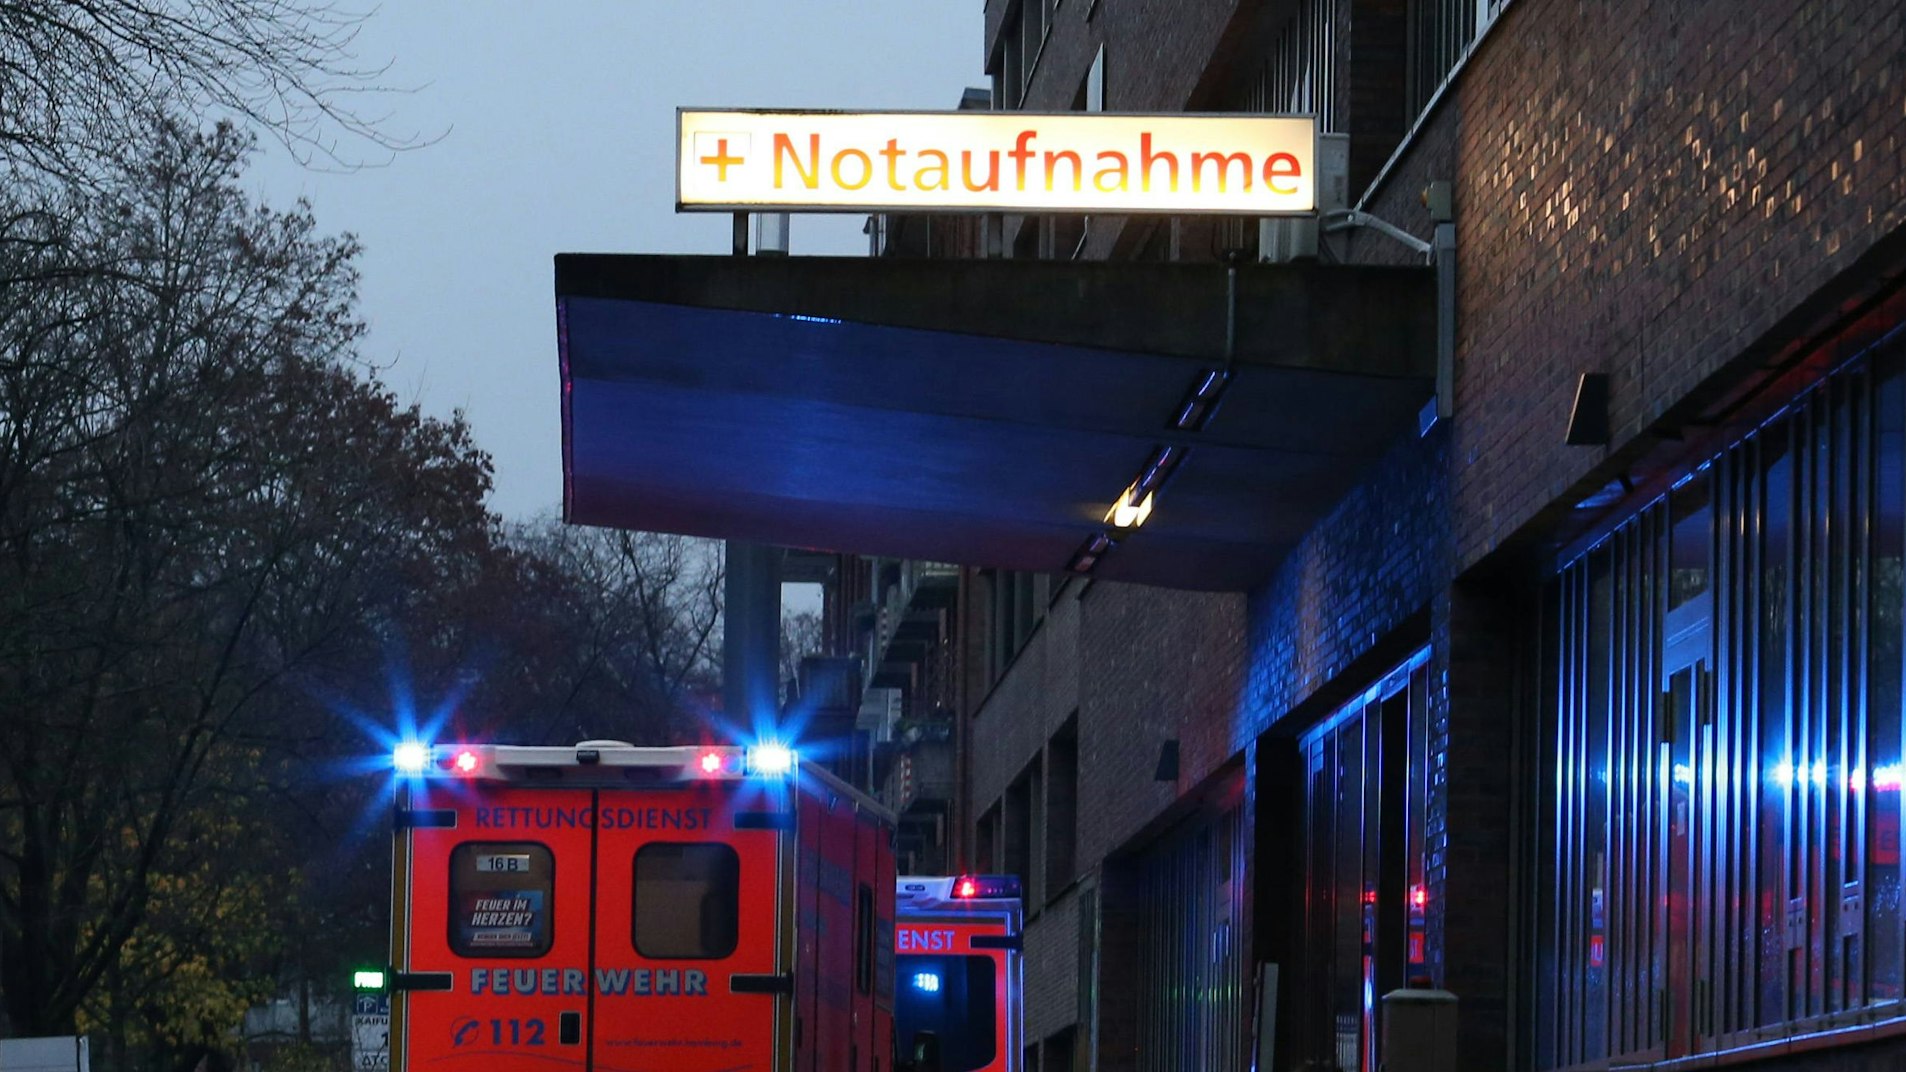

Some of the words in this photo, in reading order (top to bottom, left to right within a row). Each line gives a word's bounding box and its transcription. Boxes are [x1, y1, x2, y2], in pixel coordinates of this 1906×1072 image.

[773, 129, 1302, 194] Notaufnahme
[476, 807, 713, 829] RETTUNGSDIENST
[488, 857, 504, 869] 16
[508, 858, 518, 870] B
[475, 899, 511, 911] FEUER
[513, 898, 528, 911] IM
[472, 912, 532, 926] HERZEN?
[490, 1018, 545, 1046] 112
